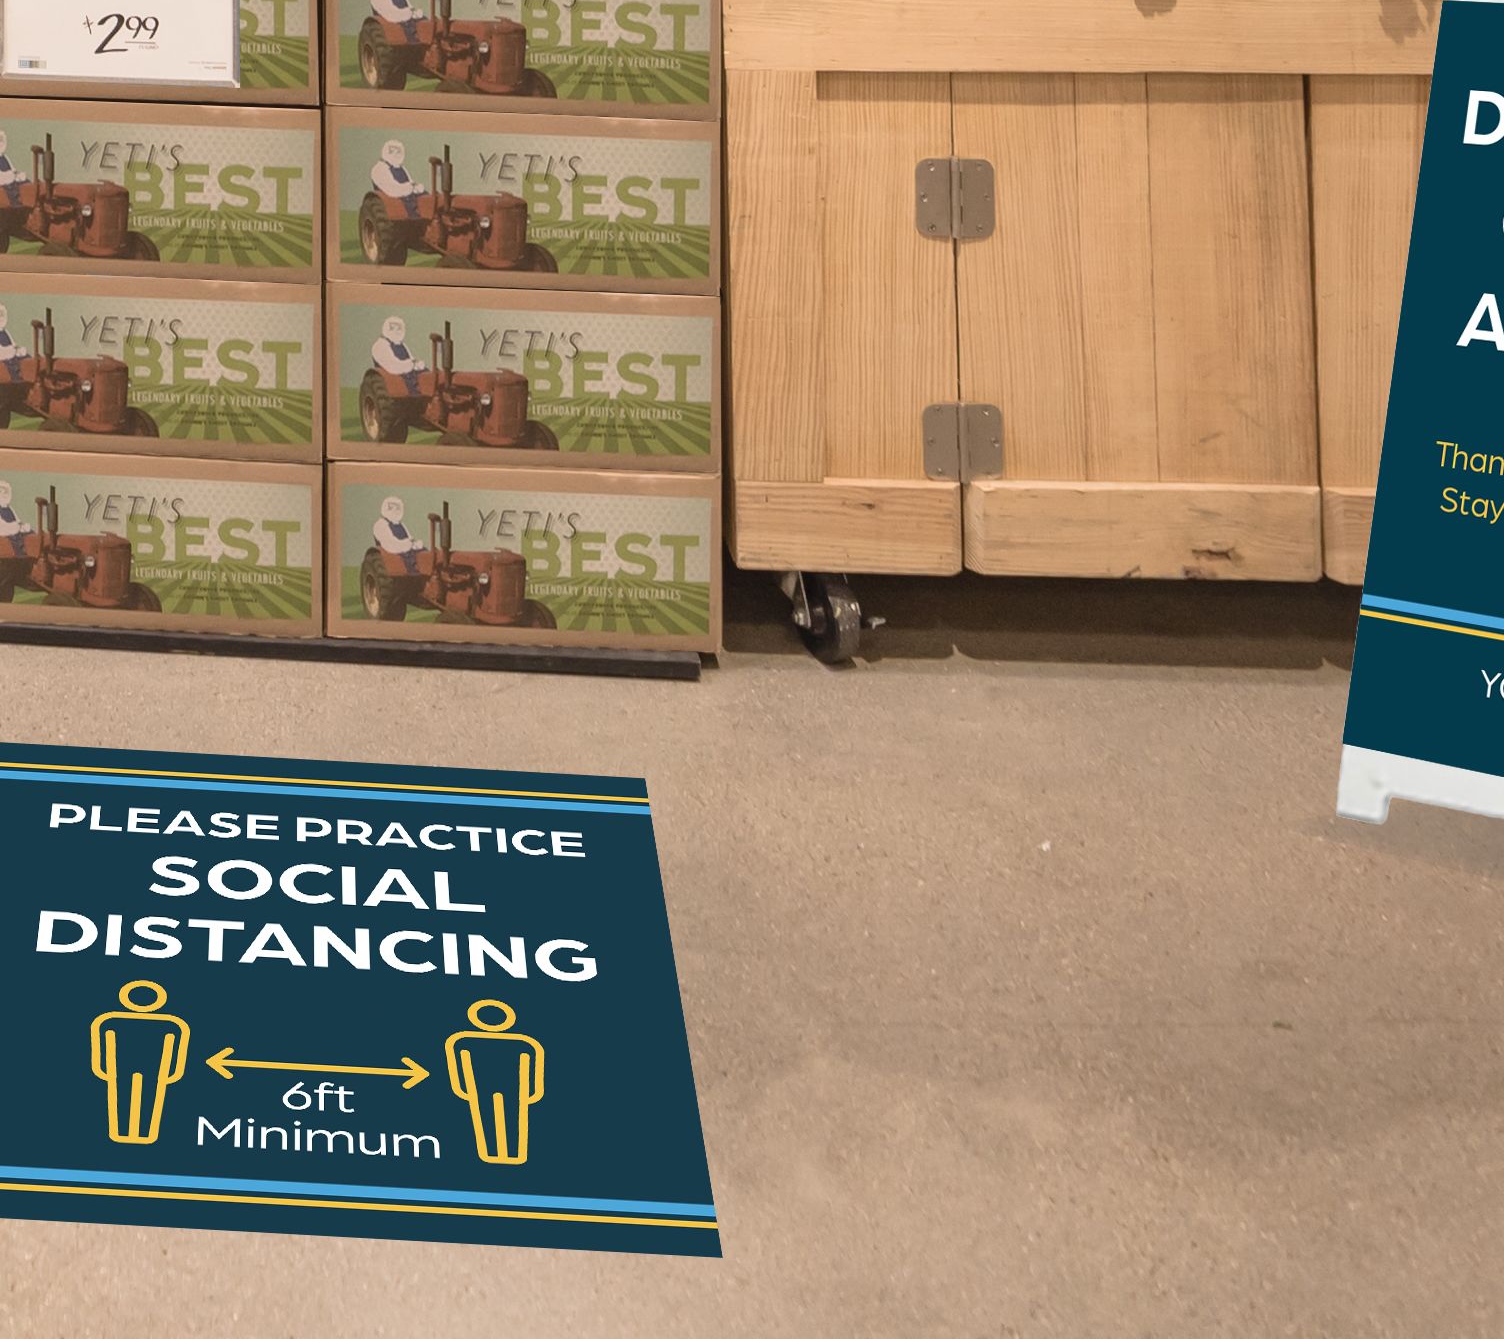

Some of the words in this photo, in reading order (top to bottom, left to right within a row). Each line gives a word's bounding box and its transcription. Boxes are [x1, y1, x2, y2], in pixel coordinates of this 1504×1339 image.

[50, 803, 279, 840] PLEASE
[297, 817, 585, 857] PRACTICE
[149, 856, 486, 912] SOCIAL
[36, 911, 597, 982] DISTANCING
[283, 1082, 354, 1113] 6ft
[198, 1116, 440, 1158] Minimum
